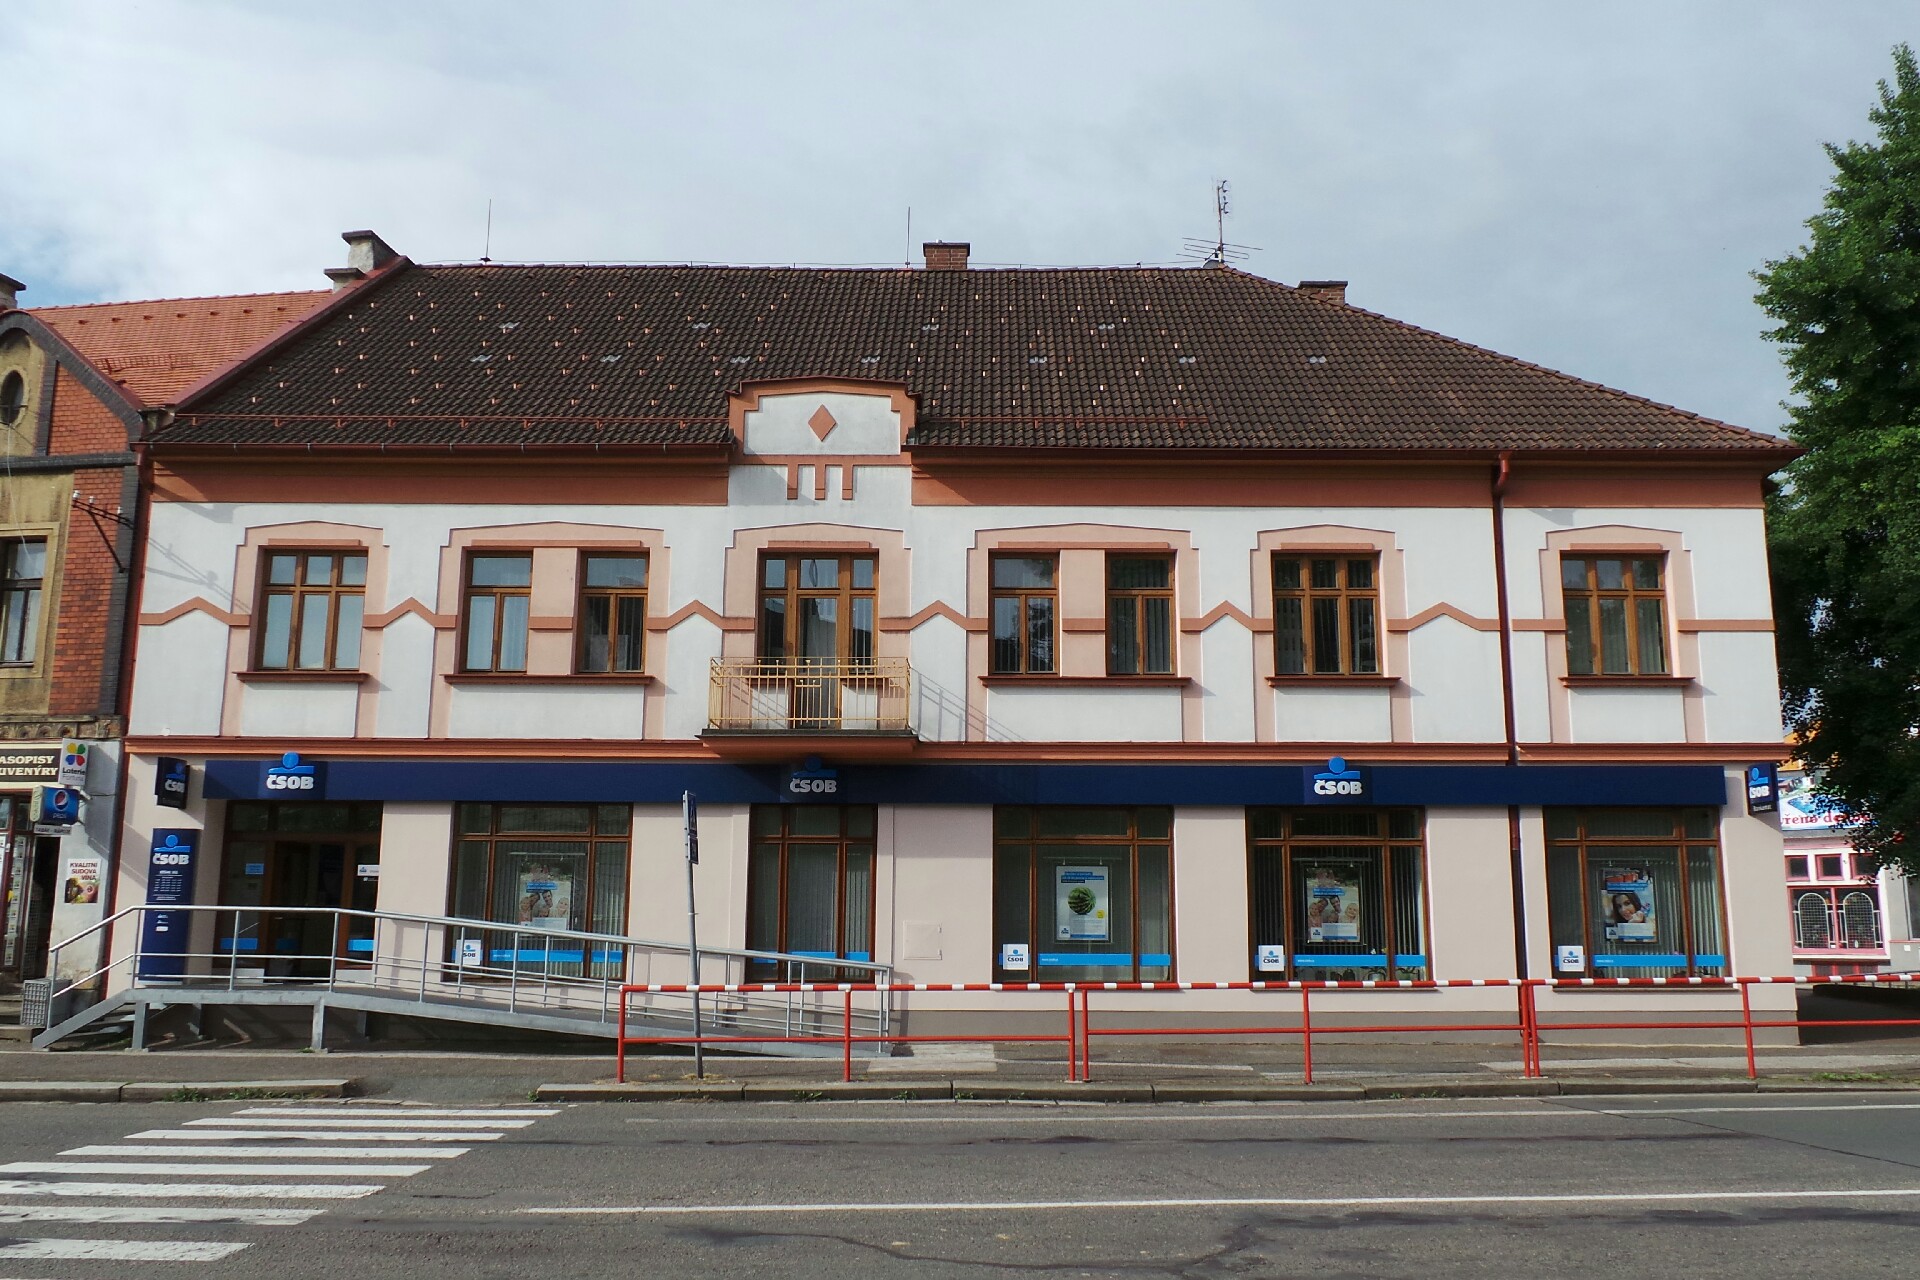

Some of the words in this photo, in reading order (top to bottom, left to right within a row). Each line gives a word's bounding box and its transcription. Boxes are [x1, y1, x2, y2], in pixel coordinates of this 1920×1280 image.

[266, 774, 314, 790] ČSOB
[789, 778, 837, 793] ČSOB
[1314, 779, 1363, 795] ČSOB
[153, 853, 189, 865] ČSOB
